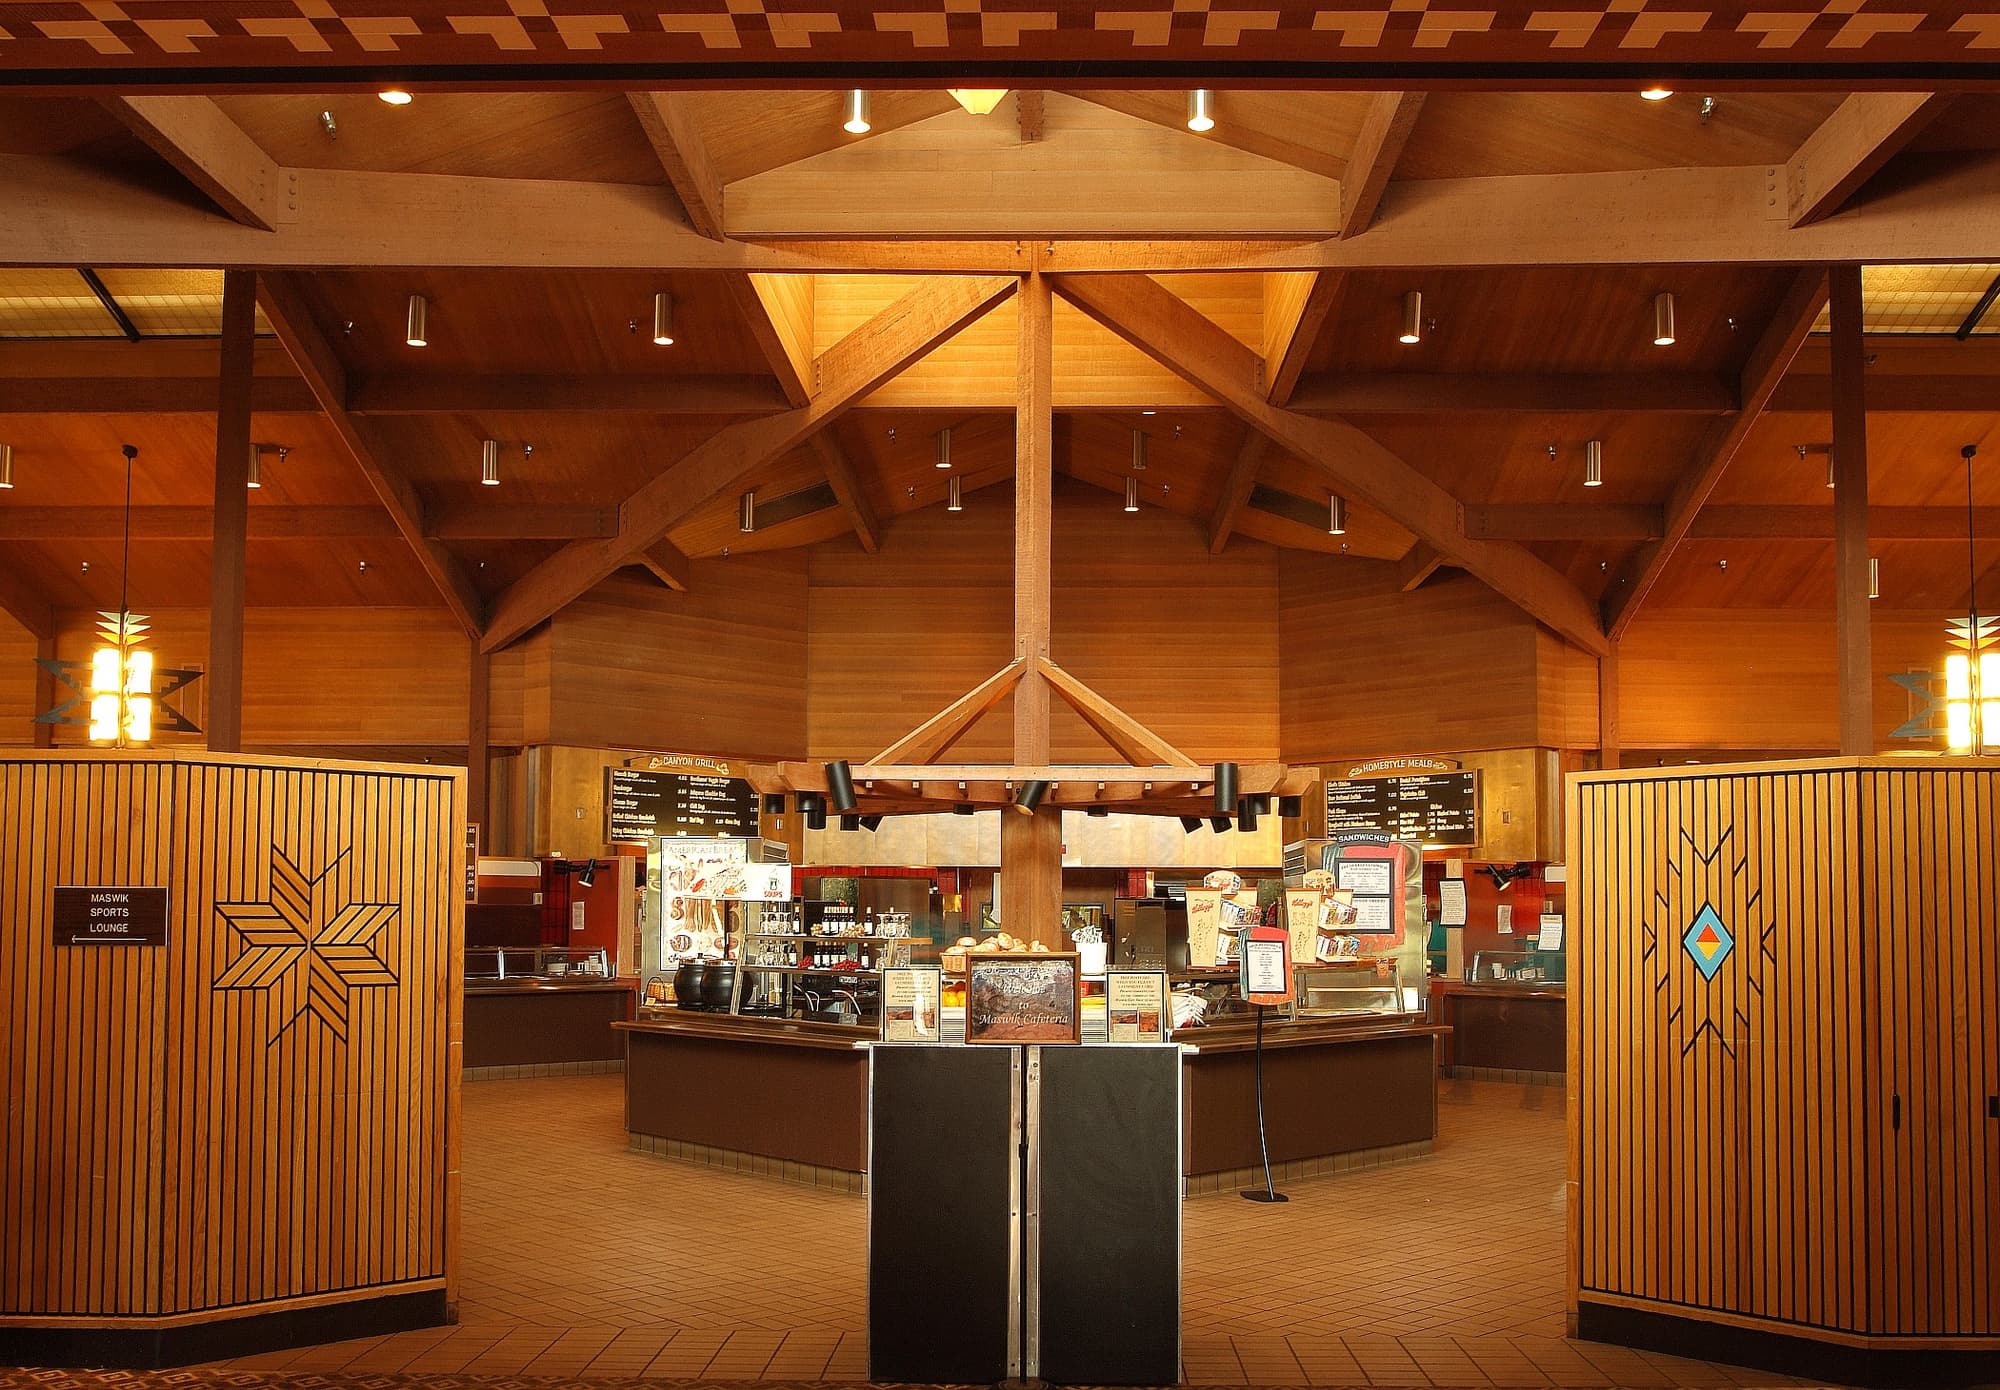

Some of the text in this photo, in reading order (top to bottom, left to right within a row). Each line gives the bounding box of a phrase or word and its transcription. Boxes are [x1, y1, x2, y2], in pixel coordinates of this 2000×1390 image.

[663, 756, 716, 769] CANYON GRILL
[1362, 759, 1434, 773] HOMESTYLE MEALS
[1338, 833, 1391, 844] SANDWICHES
[90, 893, 129, 903] MASWIK
[764, 890, 783, 898] SOUPS
[90, 907, 130, 917] SPORTS
[89, 923, 129, 933] LOUNGE
[1018, 1002, 1029, 1010] to
[979, 1013, 1068, 1026] Maswik Cafeteria
